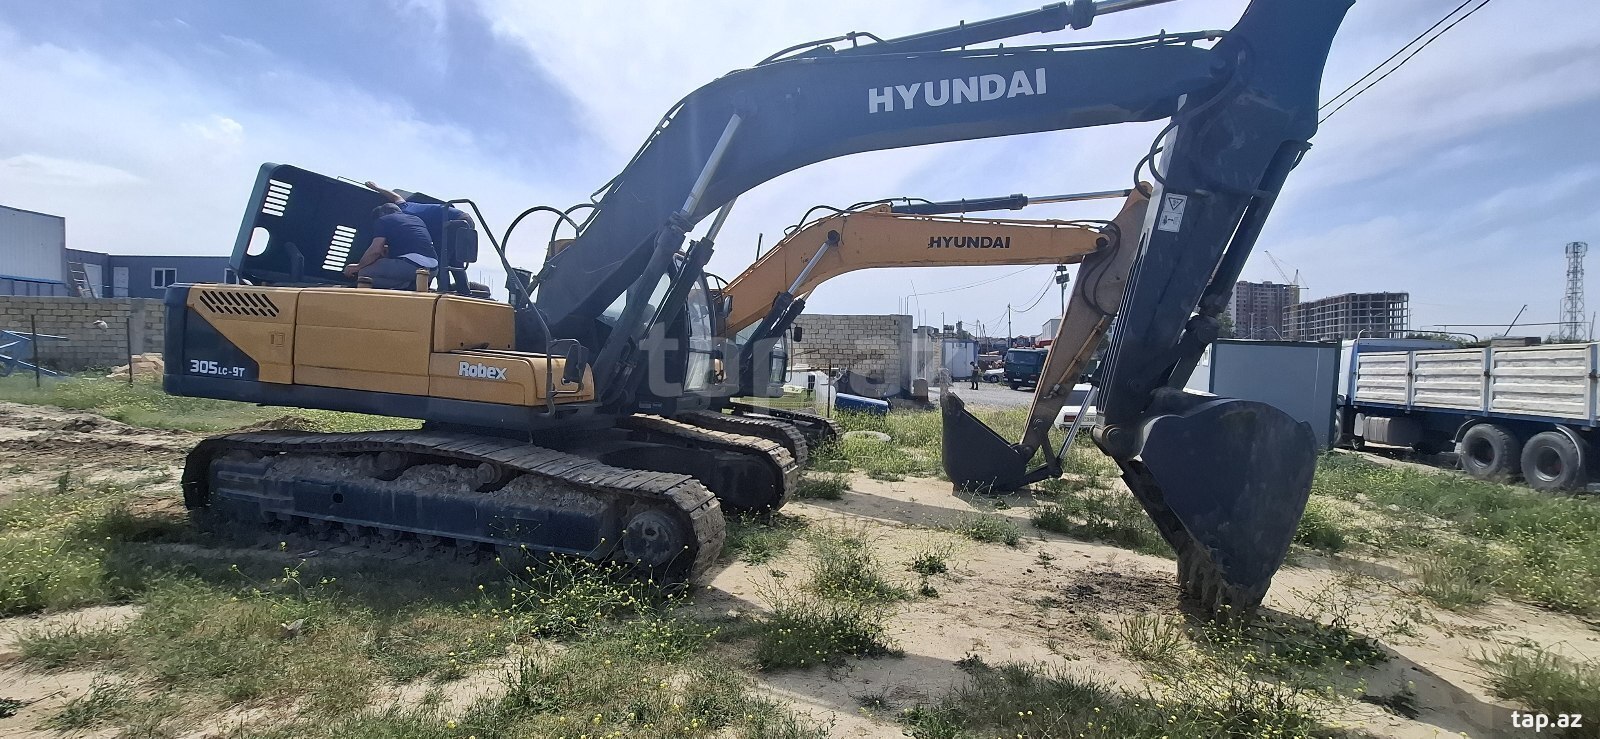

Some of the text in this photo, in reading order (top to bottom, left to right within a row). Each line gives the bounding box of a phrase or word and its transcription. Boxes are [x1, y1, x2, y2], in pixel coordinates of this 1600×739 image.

[868, 67, 1047, 114] HYUNDAI
[929, 236, 1011, 249] HYUNDAI
[458, 361, 508, 380] Robex
